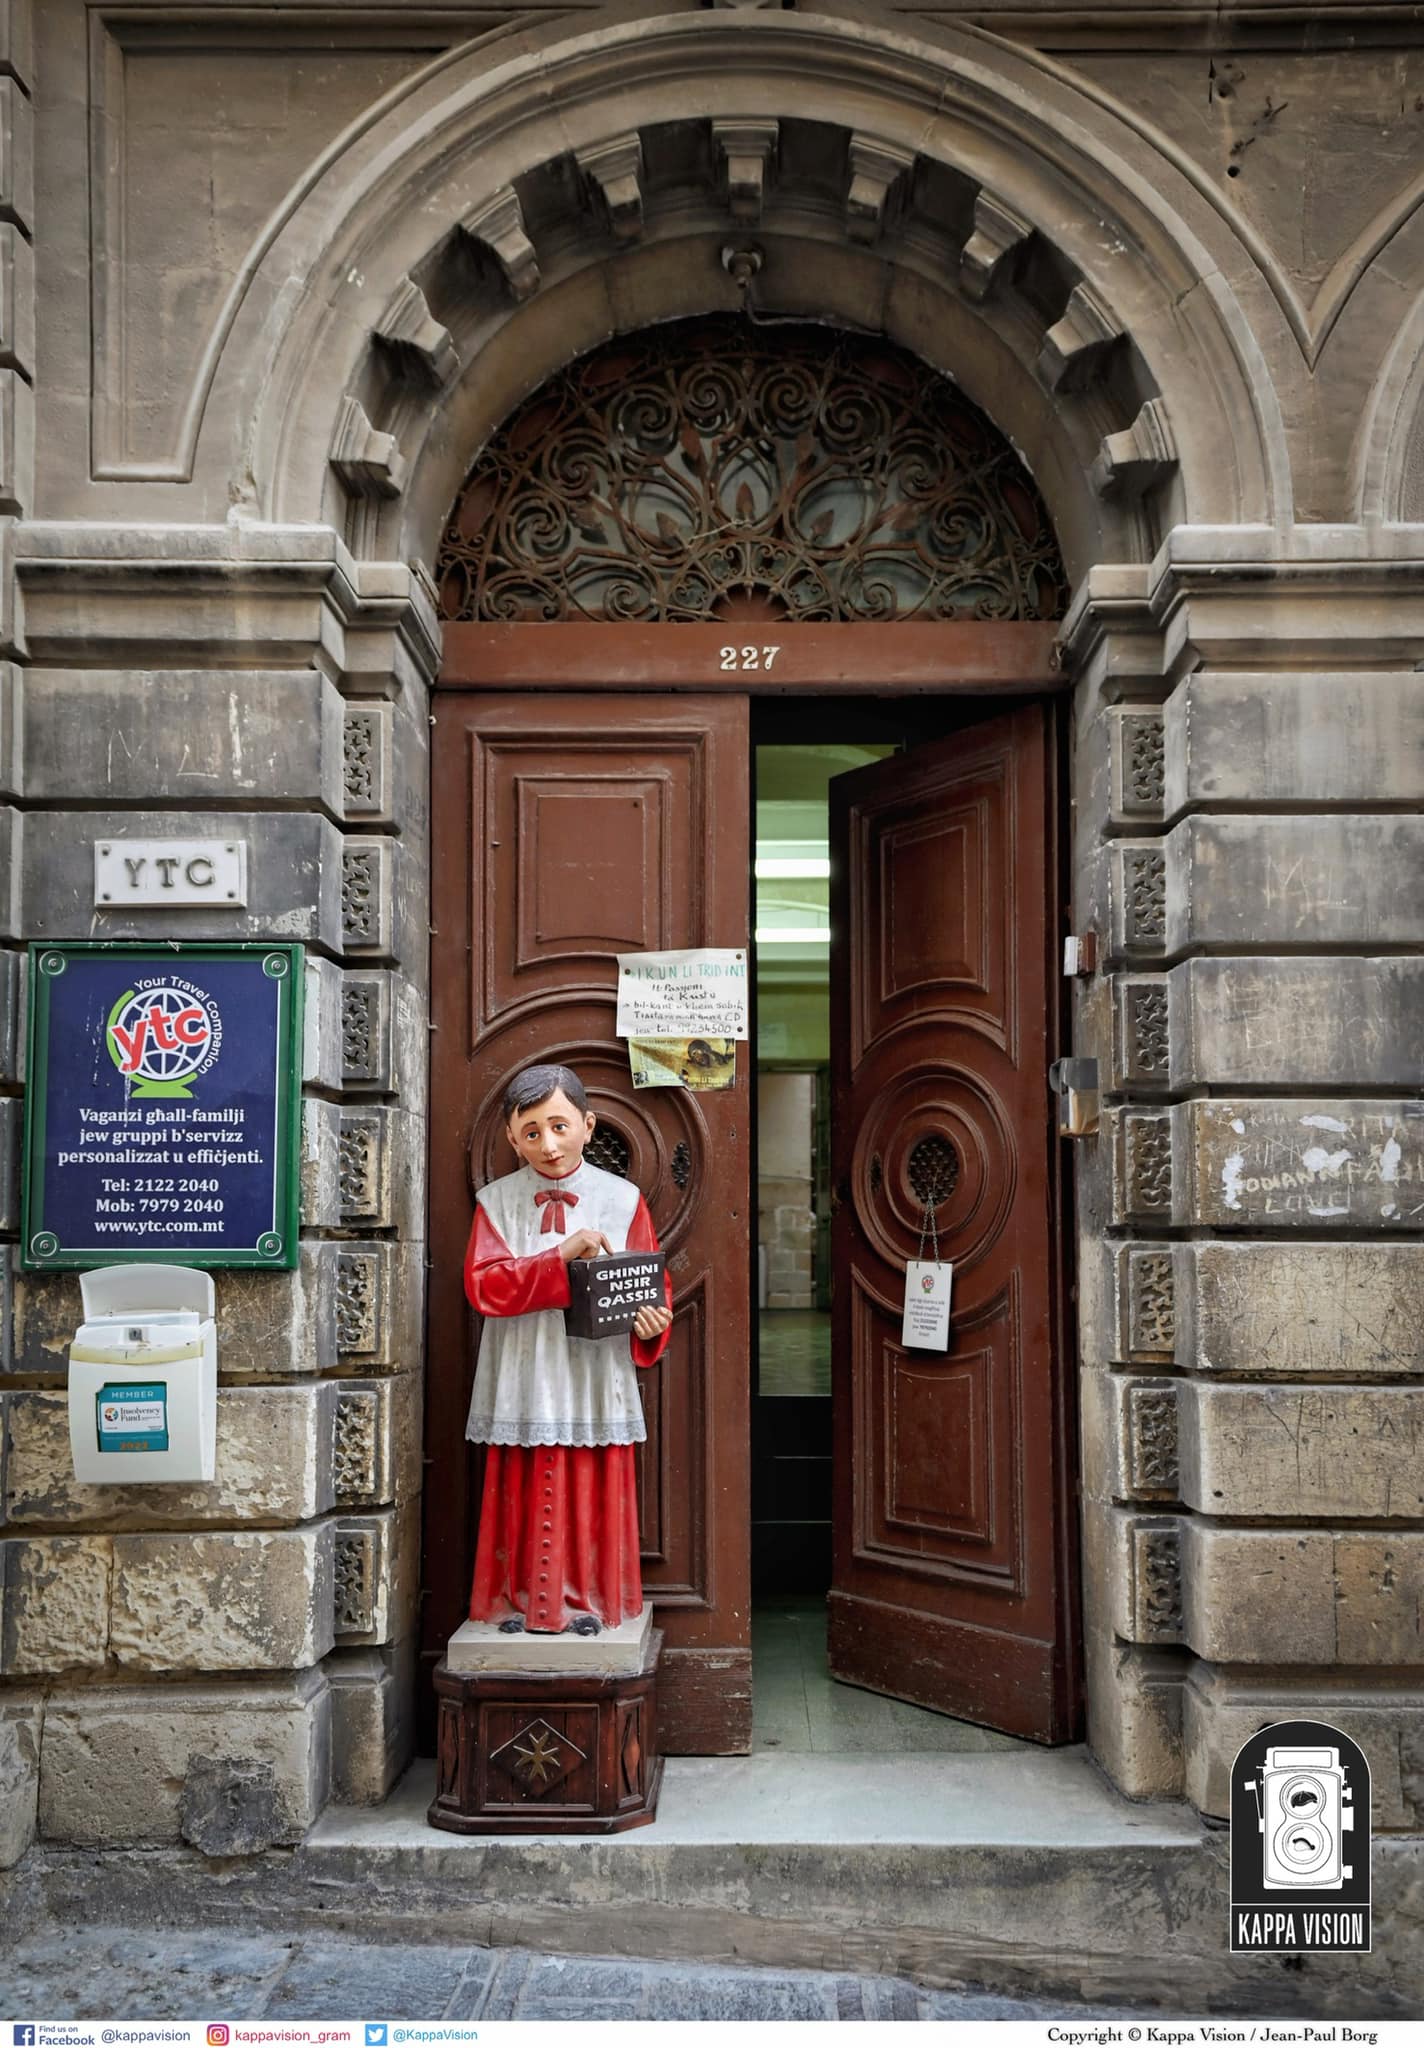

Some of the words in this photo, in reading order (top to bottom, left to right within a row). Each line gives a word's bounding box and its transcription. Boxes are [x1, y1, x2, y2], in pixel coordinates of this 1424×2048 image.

[719, 645, 780, 671] 227
[124, 857, 216, 888] YTC
[134, 977, 167, 991] Your
[171, 975, 210, 1002] Travel
[199, 1001, 222, 1074] Companion
[110, 1004, 209, 1073] ytc
[79, 1108, 142, 1125] Vaganzi
[145, 1108, 244, 1125] għall-familji
[79, 1129, 109, 1145] jew
[112, 1129, 167, 1145] gruppi
[171, 1129, 243, 1143] b'servizz
[58, 1149, 169, 1166] personalizzat
[173, 1152, 183, 1163] u
[187, 1149, 263, 1166] effiċjenti.
[102, 1178, 131, 1192] Tel:
[134, 1179, 174, 1192] 2122
[179, 1179, 219, 1192] 2040
[96, 1199, 135, 1212] Mob:
[139, 1199, 180, 1212] 7979
[183, 1199, 224, 1212] 2040
[94, 1219, 225, 1235] www.ytc.com.mt
[610, 1276, 651, 1292] NSIR
[597, 1288, 658, 1309] QASSIS
[111, 1390, 154, 1399] MEMBER
[120, 1407, 160, 1415] Insolvency
